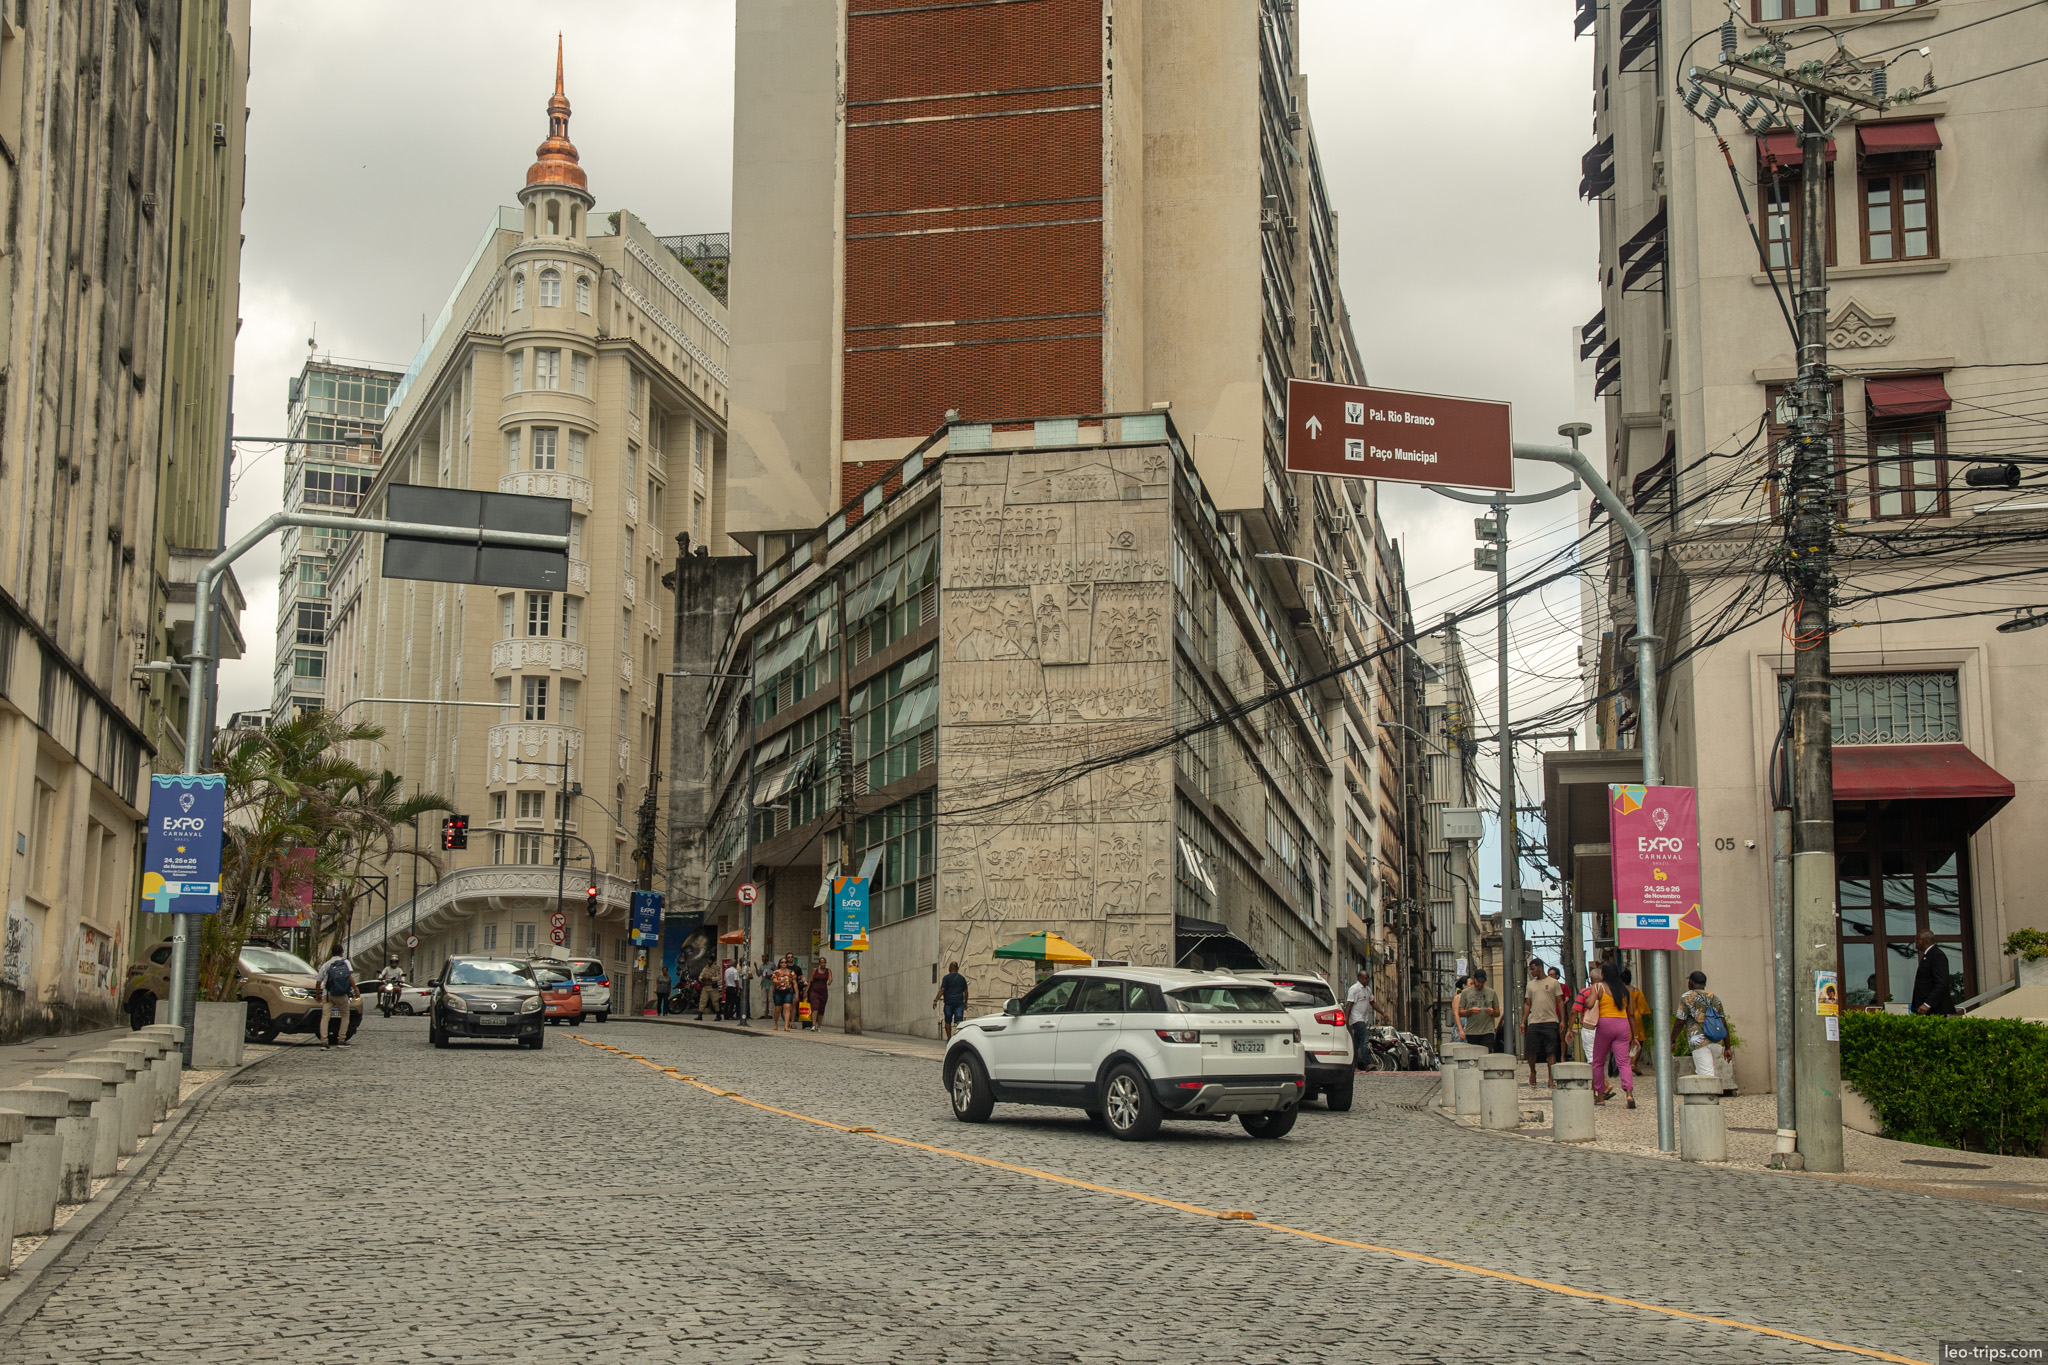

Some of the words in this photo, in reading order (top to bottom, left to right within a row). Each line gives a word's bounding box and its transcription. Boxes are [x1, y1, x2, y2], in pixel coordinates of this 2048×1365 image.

[1369, 408, 1386, 422] Pal.
[1388, 410, 1402, 423] Rio
[1404, 411, 1435, 427] Branco
[1370, 445, 1392, 462] Paço
[1394, 448, 1438, 465] Municipal
[163, 816, 204, 831] EXPO
[1638, 836, 1683, 853] EXPO
[1715, 838, 1735, 851] 05
[1644, 885, 1655, 893] 24,
[1233, 1043, 1265, 1052] NZT-2727
